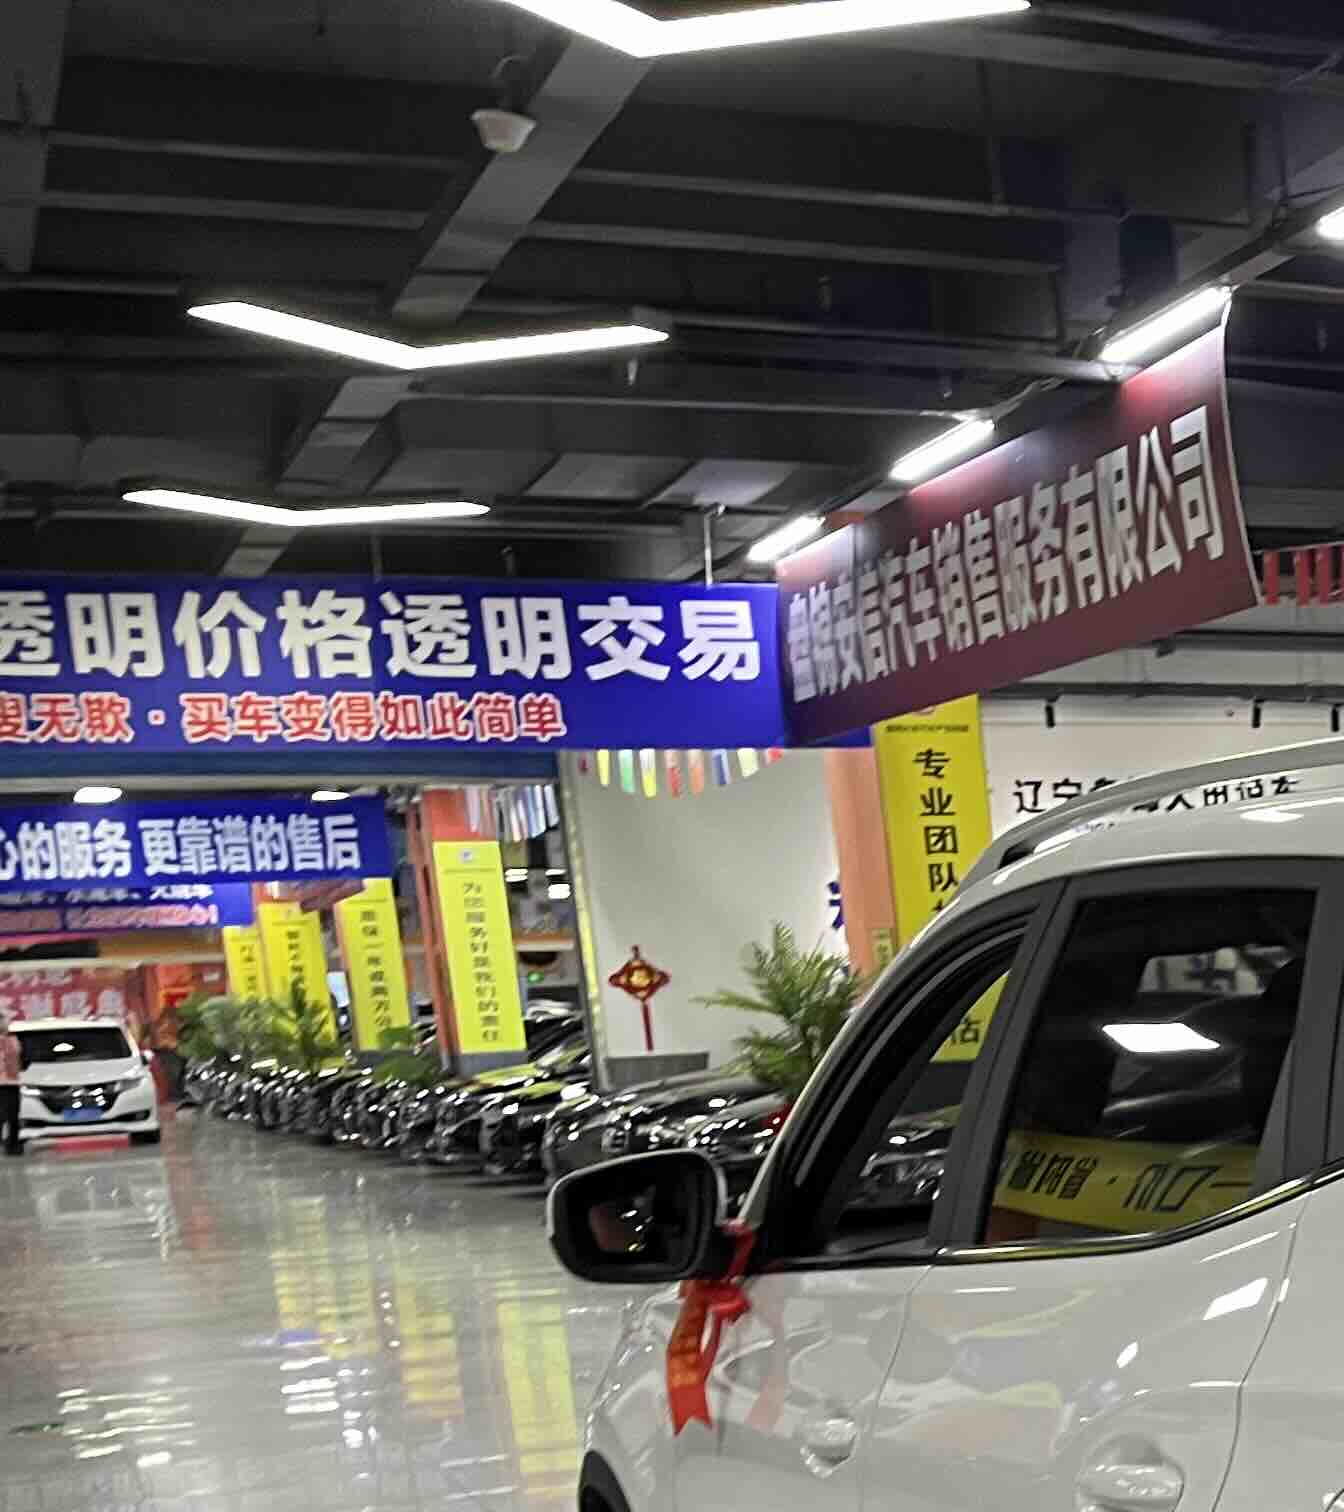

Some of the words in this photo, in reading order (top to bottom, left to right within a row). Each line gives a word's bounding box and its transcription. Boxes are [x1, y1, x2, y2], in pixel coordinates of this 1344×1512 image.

[0, 590, 761, 682] 透明价格透明交易
[138, 814, 361, 876] 更靠谱的售后
[913, 749, 958, 912] 专业团队
